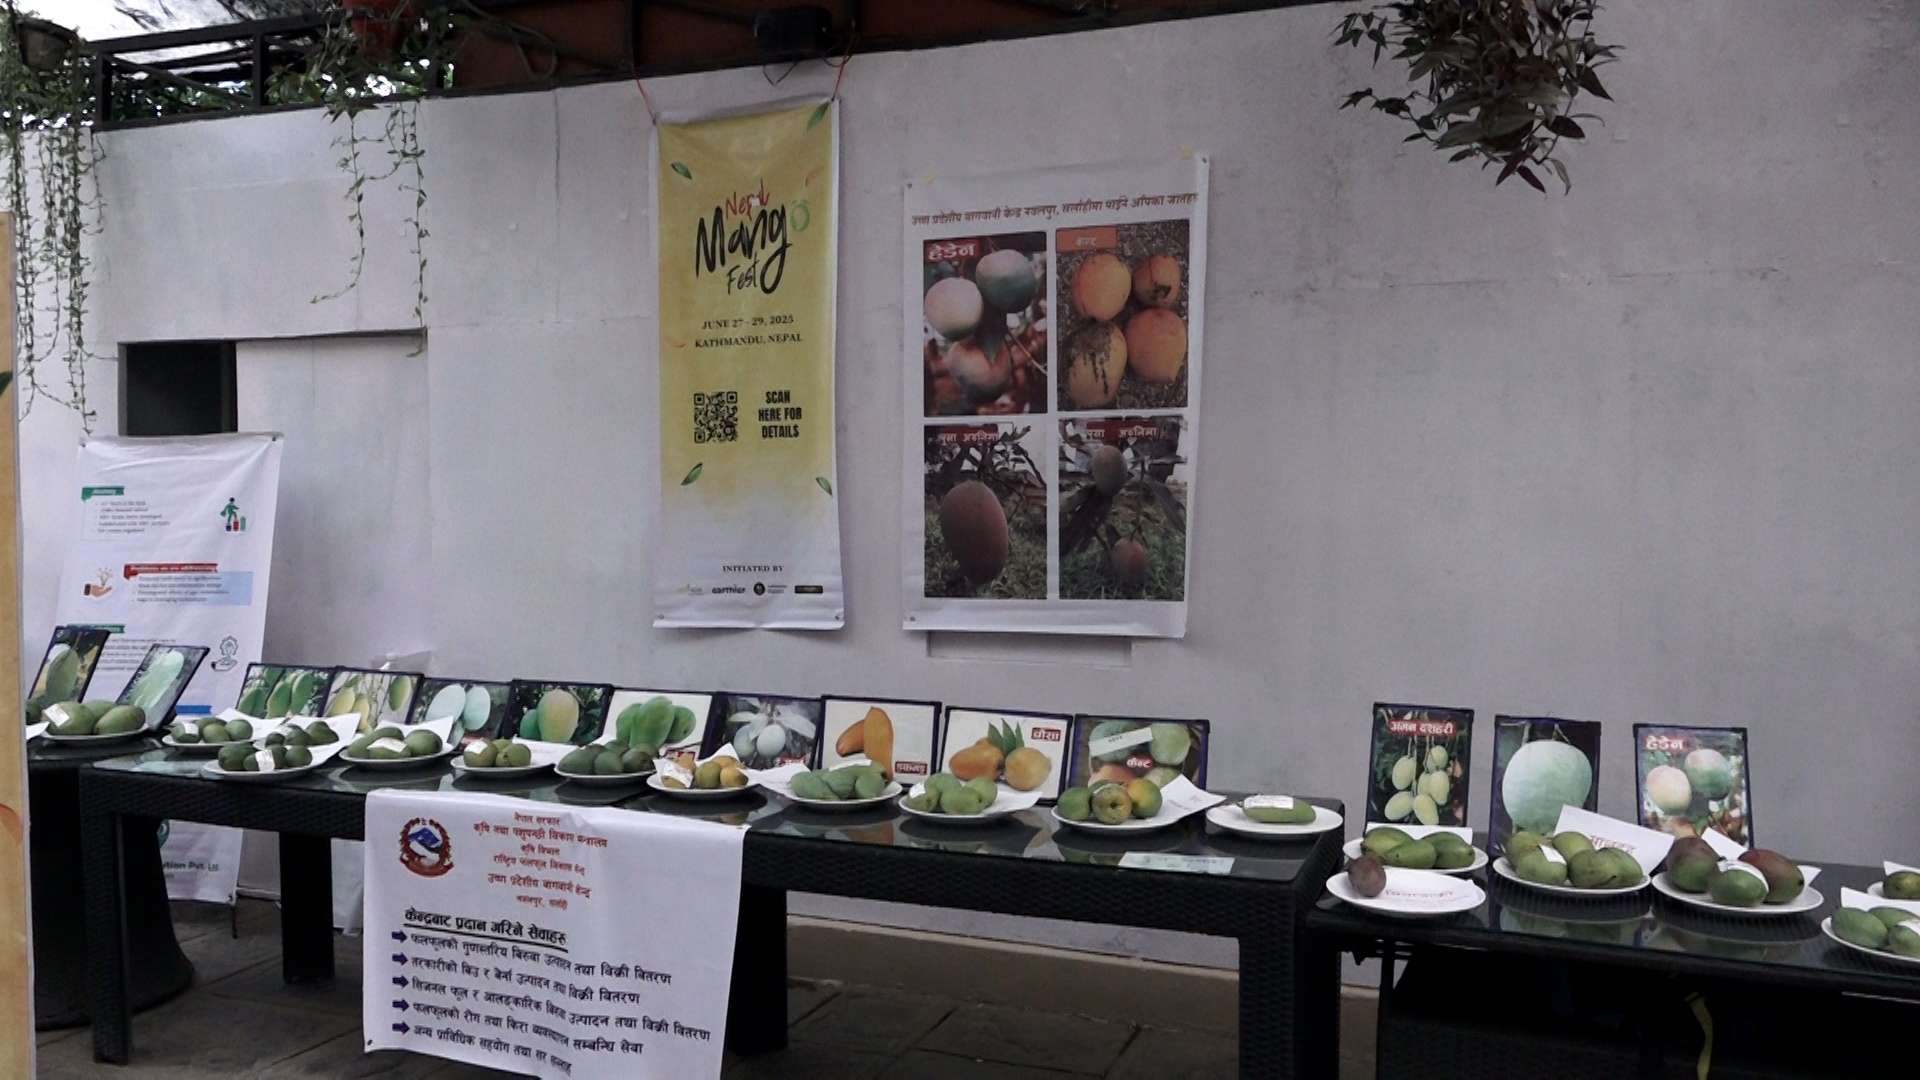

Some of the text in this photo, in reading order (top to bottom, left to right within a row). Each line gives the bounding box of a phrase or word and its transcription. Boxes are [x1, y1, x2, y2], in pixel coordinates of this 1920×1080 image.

[928, 241, 976, 261] हेडेन
[727, 253, 760, 295] Fest
[702, 319, 729, 330] JUNE
[732, 318, 744, 328] 27
[752, 316, 767, 327] 29,
[769, 313, 794, 325] 2025
[695, 333, 802, 348] KATHMANDU, NEPAL
[766, 390, 790, 404] SCAN
[758, 407, 802, 422] HERE FOR
[762, 424, 799, 439] DETAILS
[455, 917, 486, 932] प्रदान
[491, 919, 523, 937] गरिने
[411, 933, 458, 951] फलफूलको
[575, 963, 595, 976] तथा
[411, 957, 457, 973] तरकारीको
[450, 986, 468, 1001] फूल
[568, 1013, 610, 1027] उत्पादन
[615, 1016, 638, 1029] तथा
[412, 1002, 460, 1020] फलफूलको
[484, 1015, 503, 1028] तथा
[620, 1039, 644, 1054] सेवा
[479, 1037, 510, 1053] सहयोग
[513, 1045, 532, 1058] तथा
